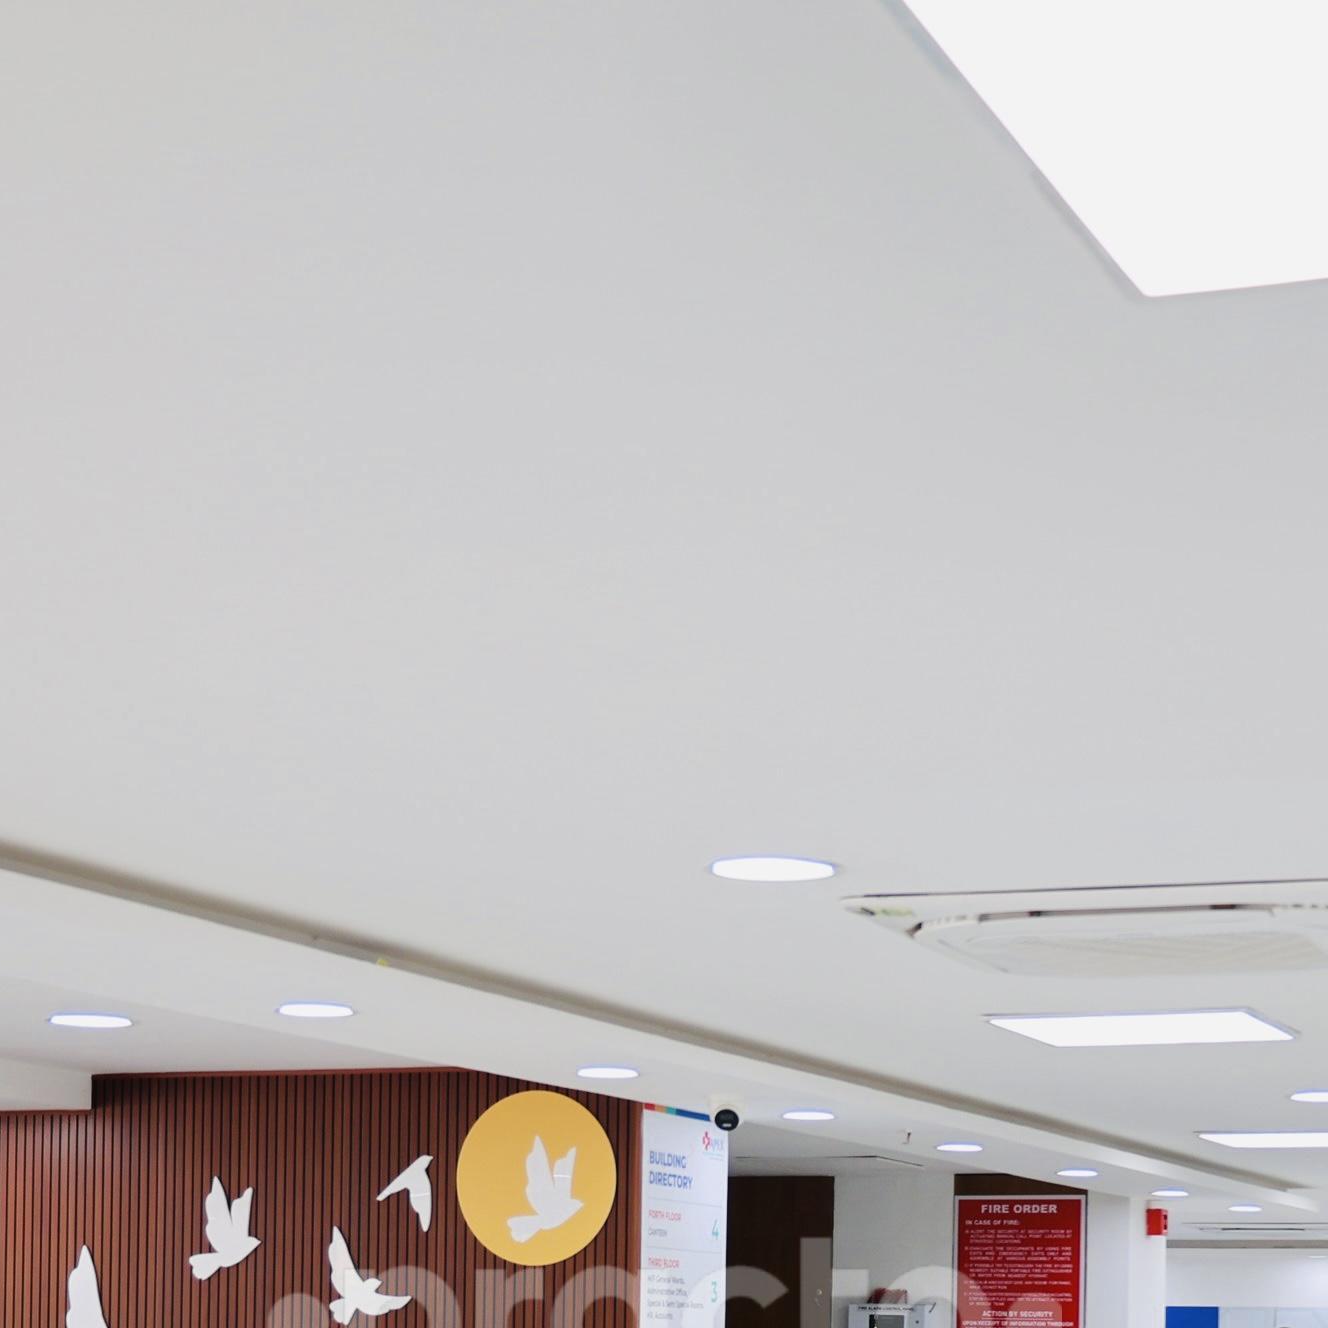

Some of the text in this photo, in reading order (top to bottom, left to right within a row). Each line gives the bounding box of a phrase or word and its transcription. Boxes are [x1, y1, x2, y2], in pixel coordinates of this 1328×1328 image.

[649, 1150, 687, 1169] BUILDING
[649, 1170, 693, 1190] DIRECTORY
[981, 1204, 1058, 1214] FIRE ORDER
[665, 1211, 682, 1221] FLOOR
[712, 1219, 720, 1240] 4
[664, 1259, 680, 1269] FLOOR
[710, 1281, 718, 1303] 3
[982, 1310, 1054, 1318] ACTION BY SECURITY
